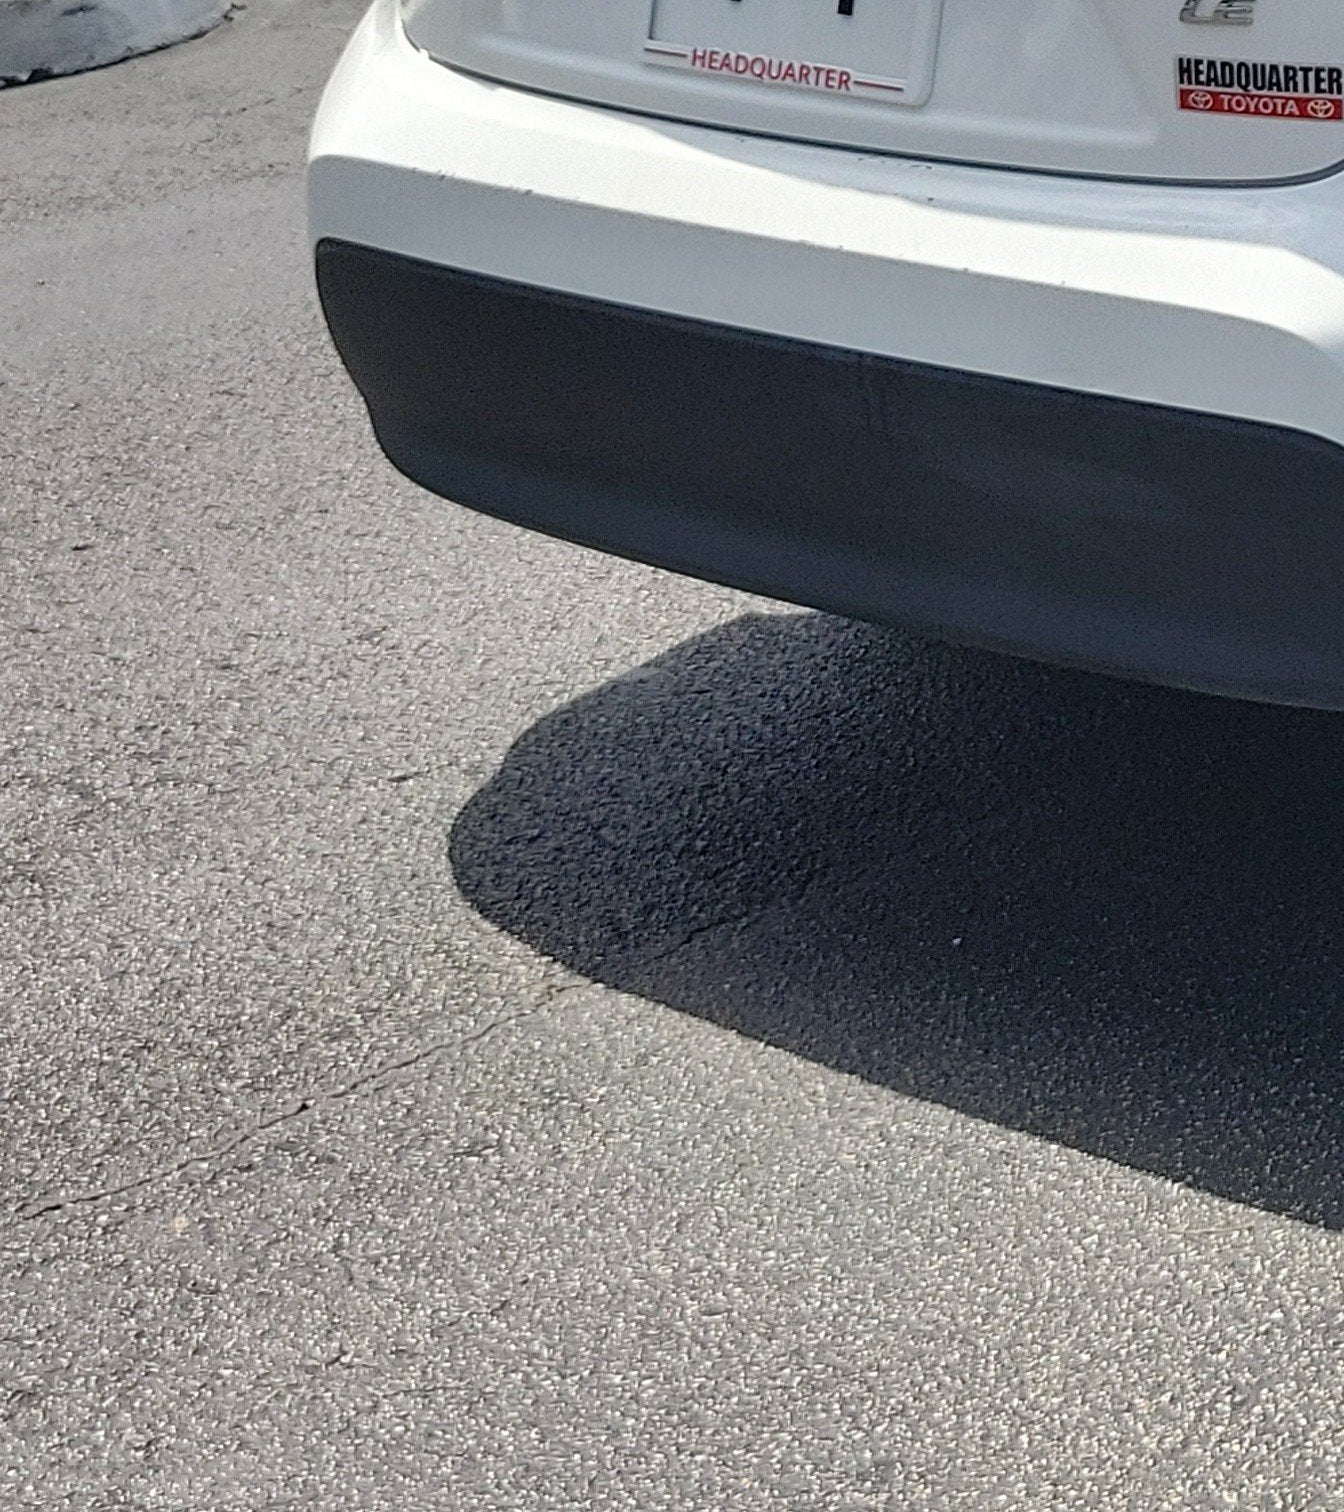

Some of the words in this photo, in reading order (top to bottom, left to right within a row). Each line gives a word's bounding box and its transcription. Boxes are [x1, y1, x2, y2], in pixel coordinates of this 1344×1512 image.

[691, 47, 851, 92] HEADQUARTER
[1177, 56, 1343, 95] HEADQUARTER
[1219, 93, 1301, 116] TOYOTA
